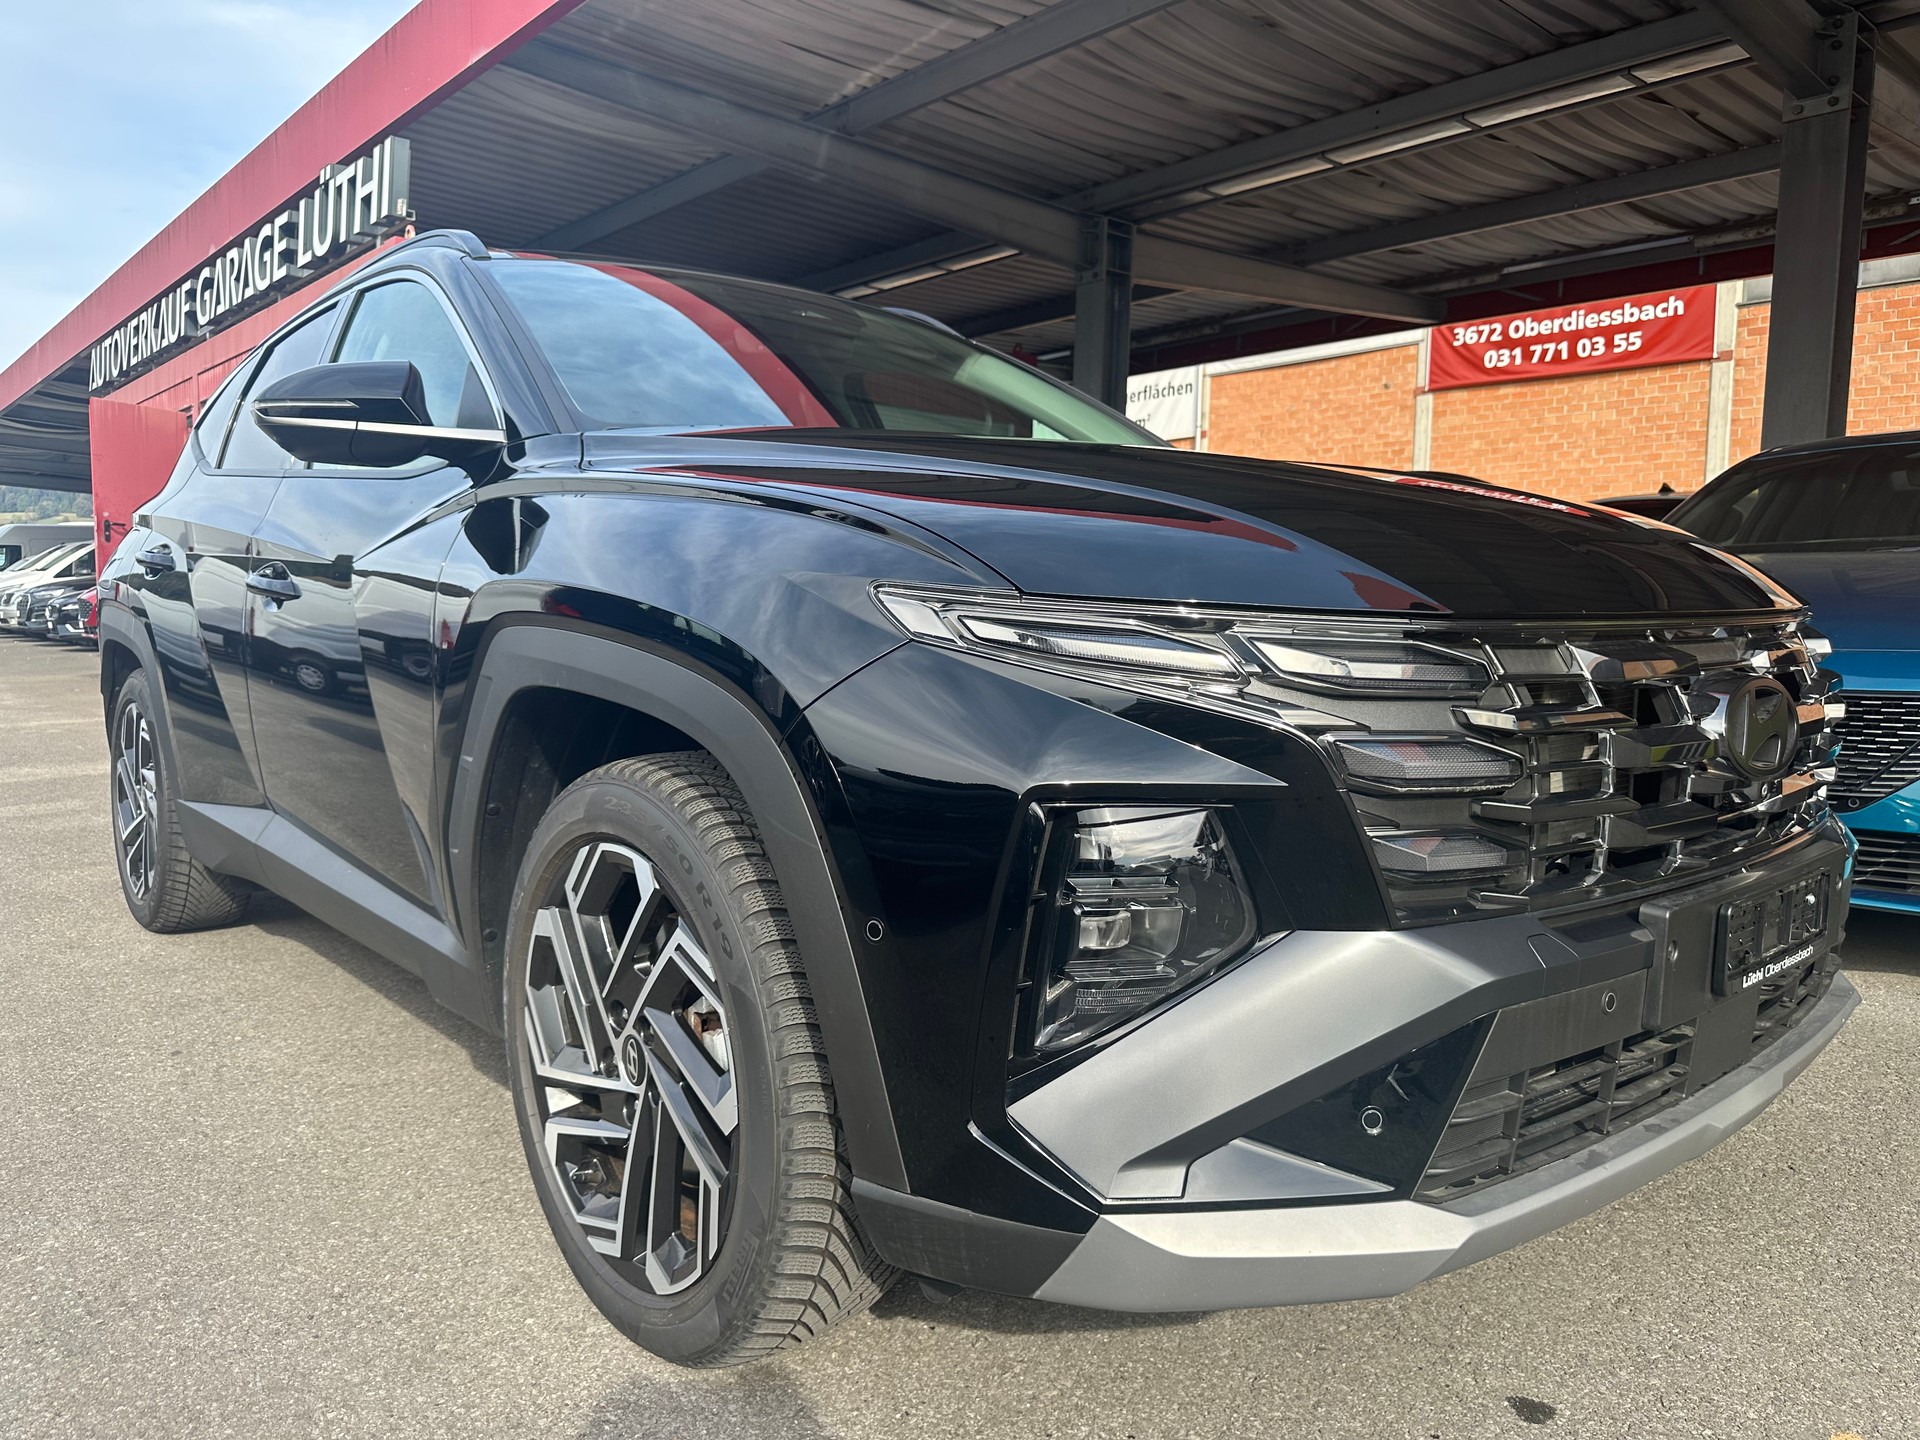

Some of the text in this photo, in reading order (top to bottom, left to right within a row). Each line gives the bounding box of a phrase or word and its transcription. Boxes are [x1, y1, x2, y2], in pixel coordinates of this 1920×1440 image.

[89, 135, 393, 392] AUTOVERKAUF GARAGE LÜTHI
[1452, 296, 1685, 347] 3672 Oberdiessbach
[1483, 331, 1643, 369] 031 771 03 55
[1129, 382, 1193, 403] erflächen
[1742, 945, 1814, 989] Lüthi Oberdiessbach
